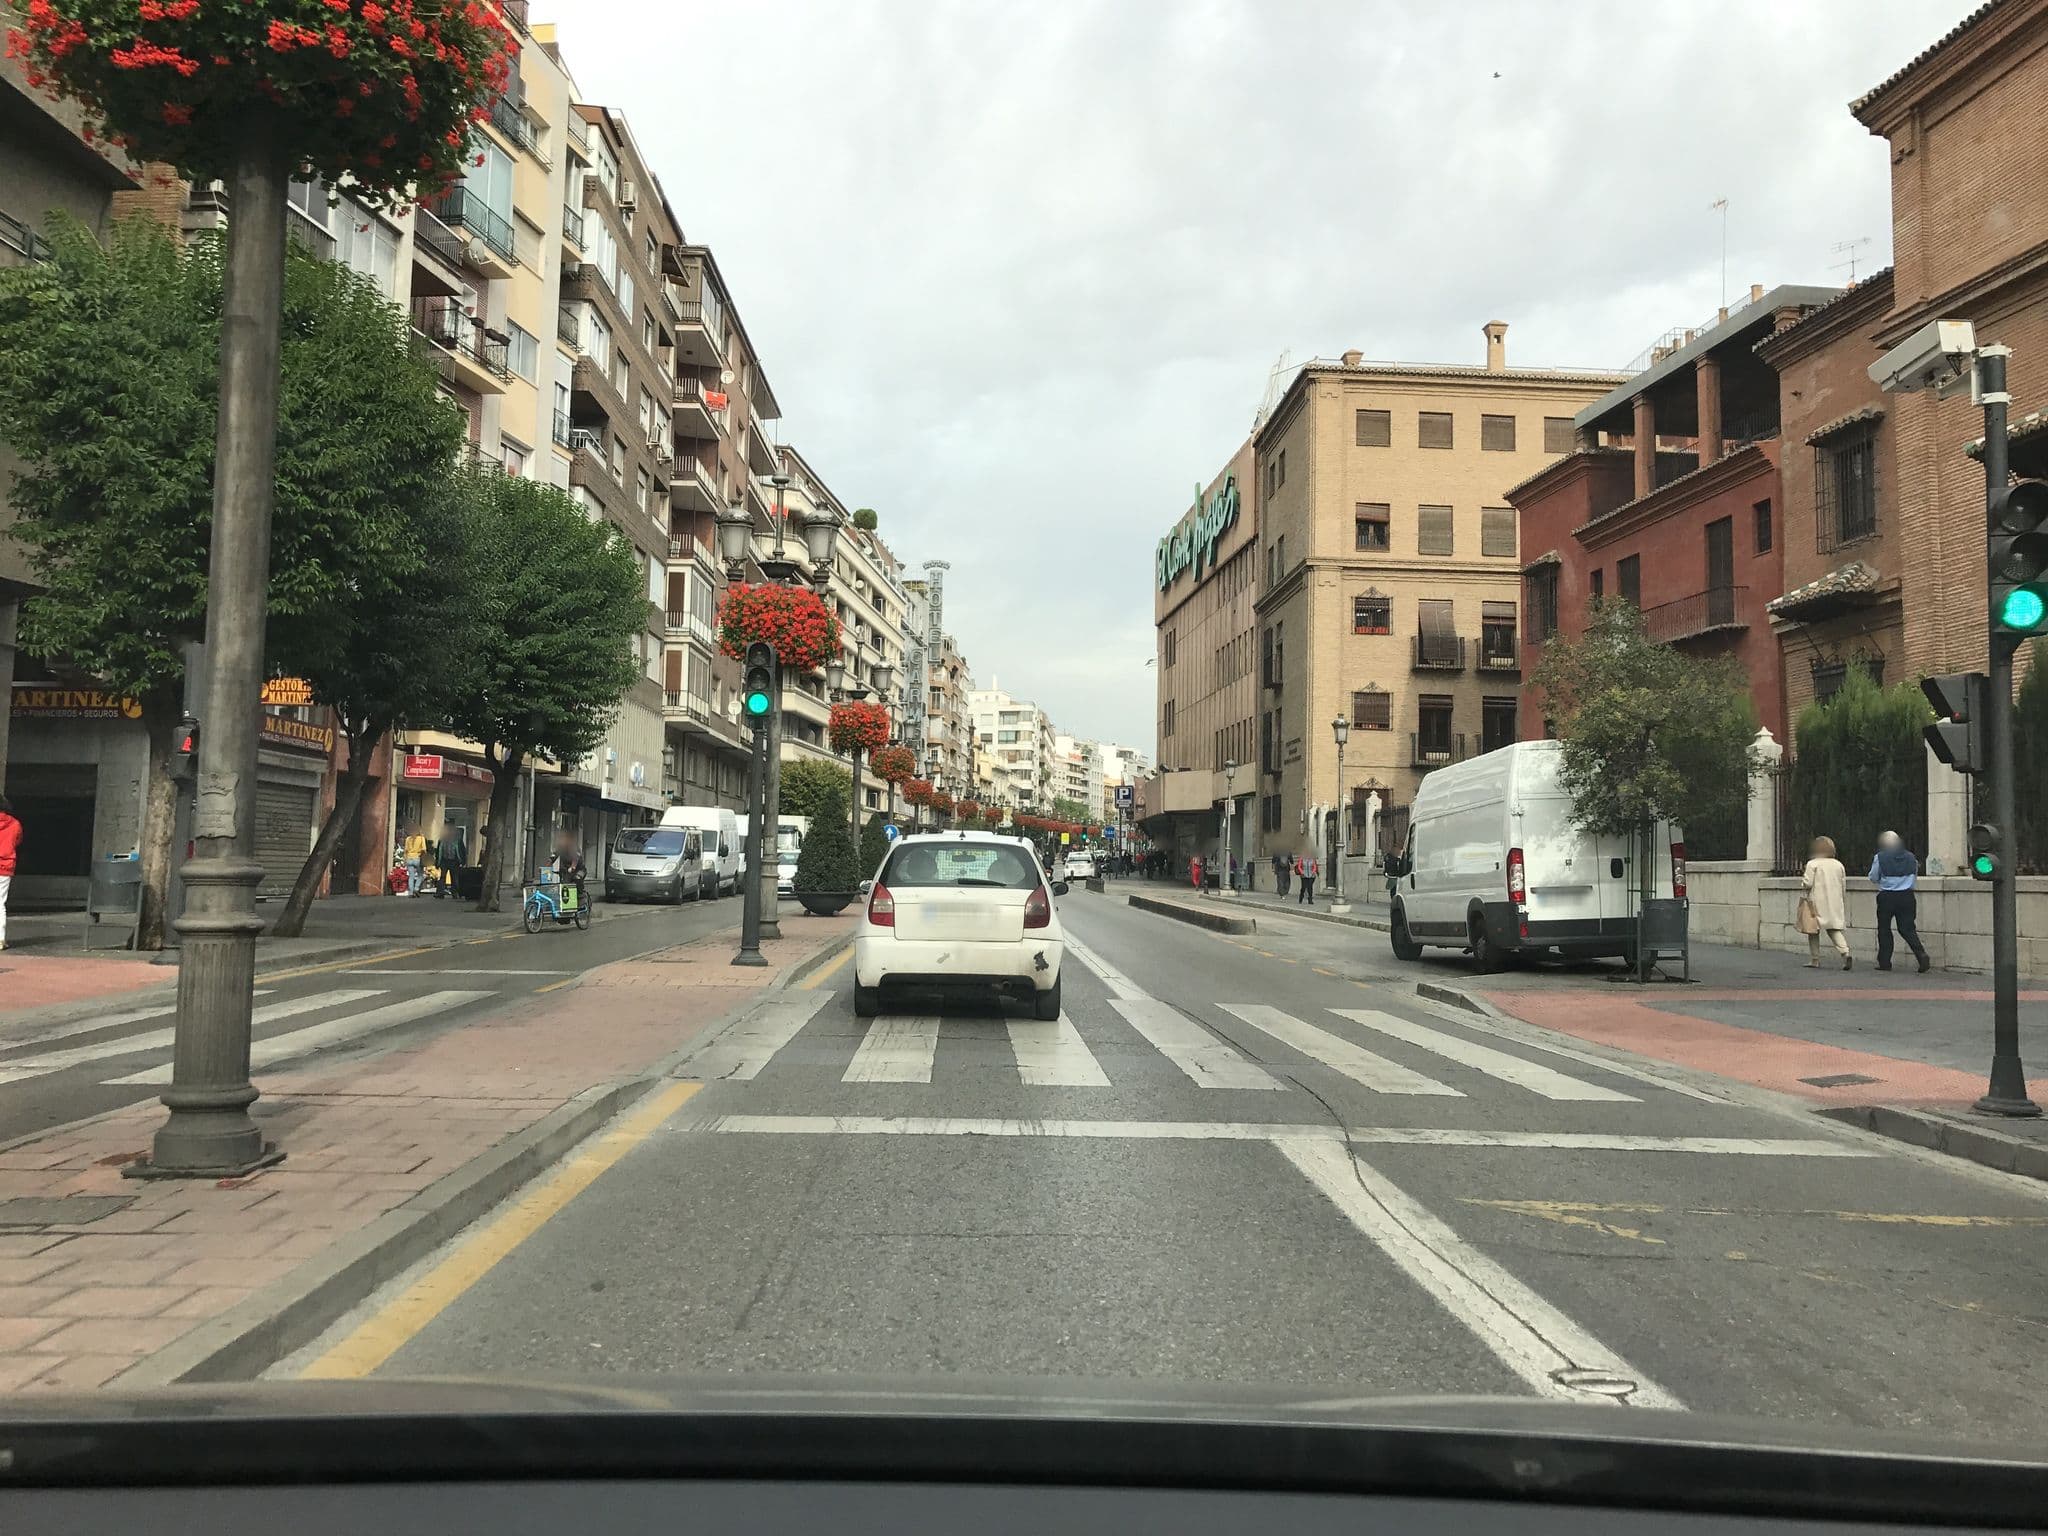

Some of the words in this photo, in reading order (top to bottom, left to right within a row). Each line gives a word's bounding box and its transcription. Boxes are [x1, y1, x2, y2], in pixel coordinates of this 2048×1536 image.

[928, 571, 943, 663] HOTEL
[15, 690, 119, 707] ARTINEZ
[268, 691, 311, 704] MARTINE
[909, 648, 923, 754] CARME
[84, 709, 119, 718] SEGUROS
[265, 716, 324, 742] MARTINEZ
[1119, 788, 1130, 800] P
